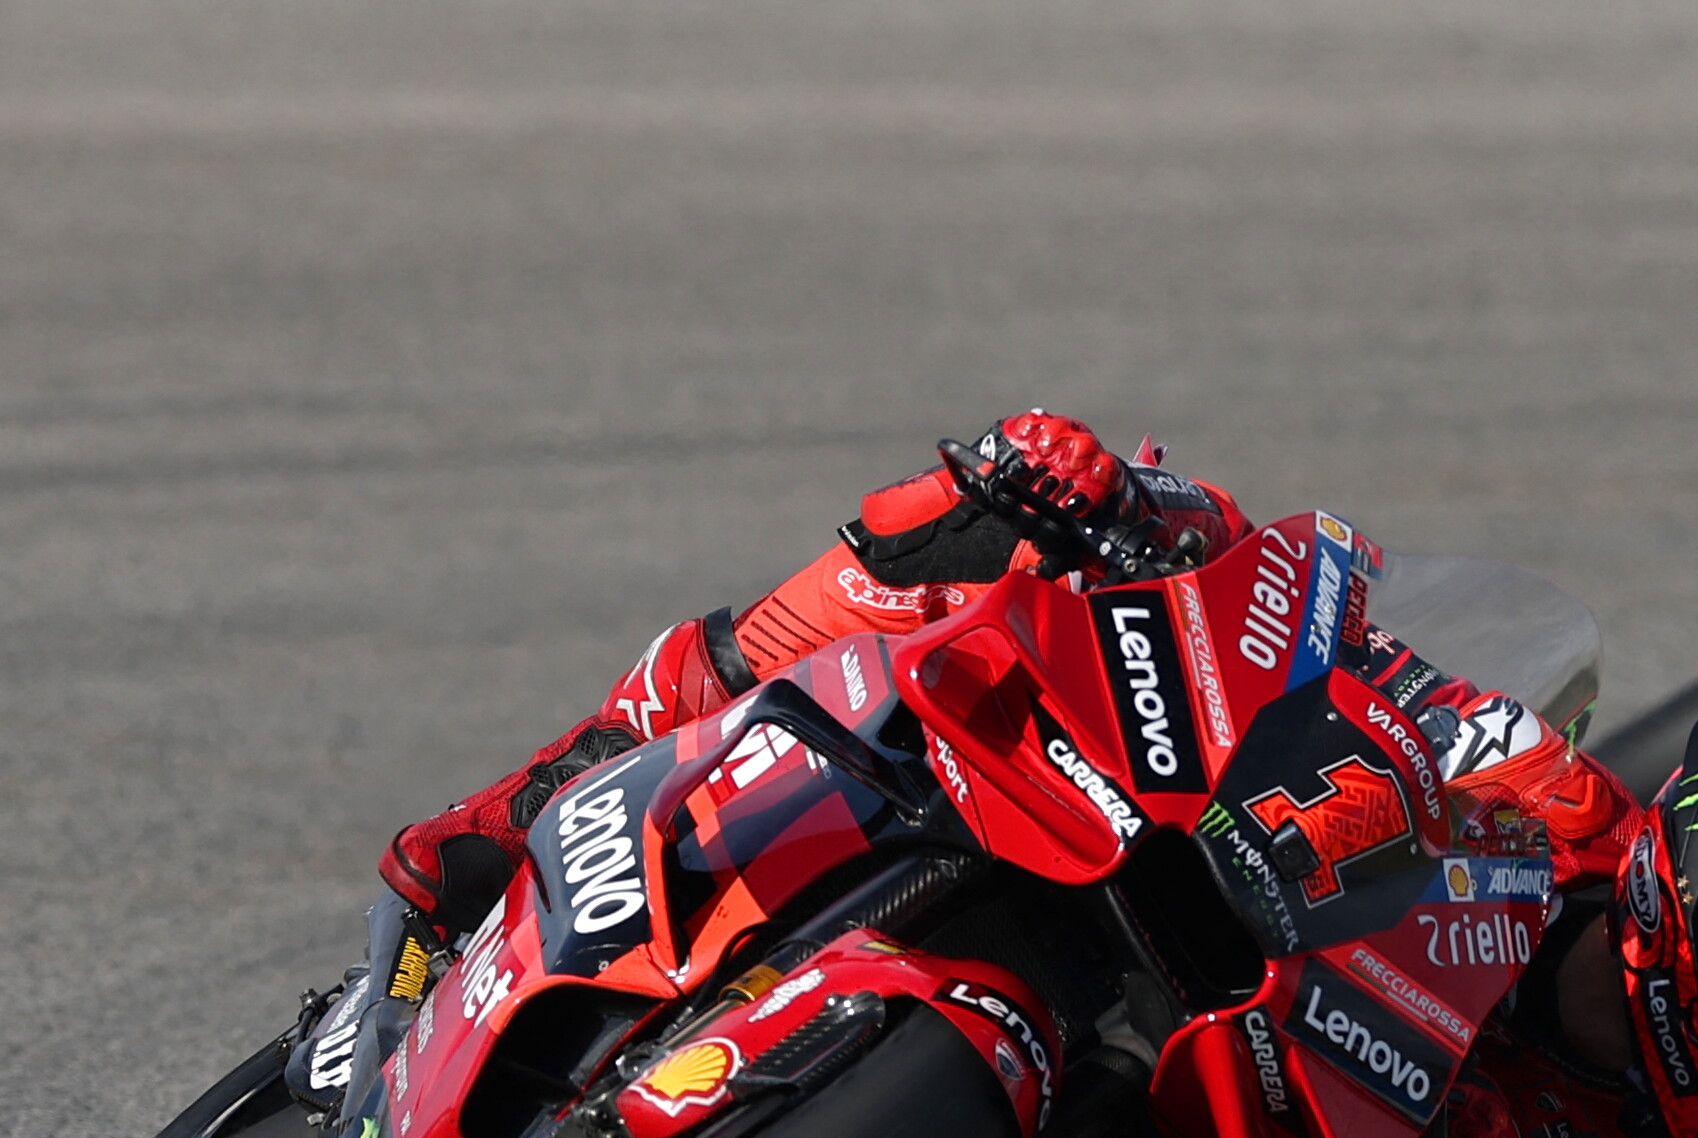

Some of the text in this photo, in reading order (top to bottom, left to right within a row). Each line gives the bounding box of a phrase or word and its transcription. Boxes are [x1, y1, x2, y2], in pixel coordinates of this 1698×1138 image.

[1178, 581, 1233, 749] FRECCIAROSSA
[1239, 546, 1300, 670] riello
[1111, 606, 1179, 777] Lenovo
[559, 755, 645, 933] Lenovo
[1046, 738, 1142, 838] CARRERA
[1242, 755, 1415, 909] 1
[1227, 829, 1299, 952] MONSTER
[1448, 914, 1530, 965] riello
[949, 983, 1053, 1131] Lenovo
[1304, 985, 1431, 1103] Lenovo
[1351, 948, 1471, 1043] FRECCIAROSSA
[1648, 978, 1690, 1087] Lenovo
[1244, 1010, 1287, 1115] CARRERA
